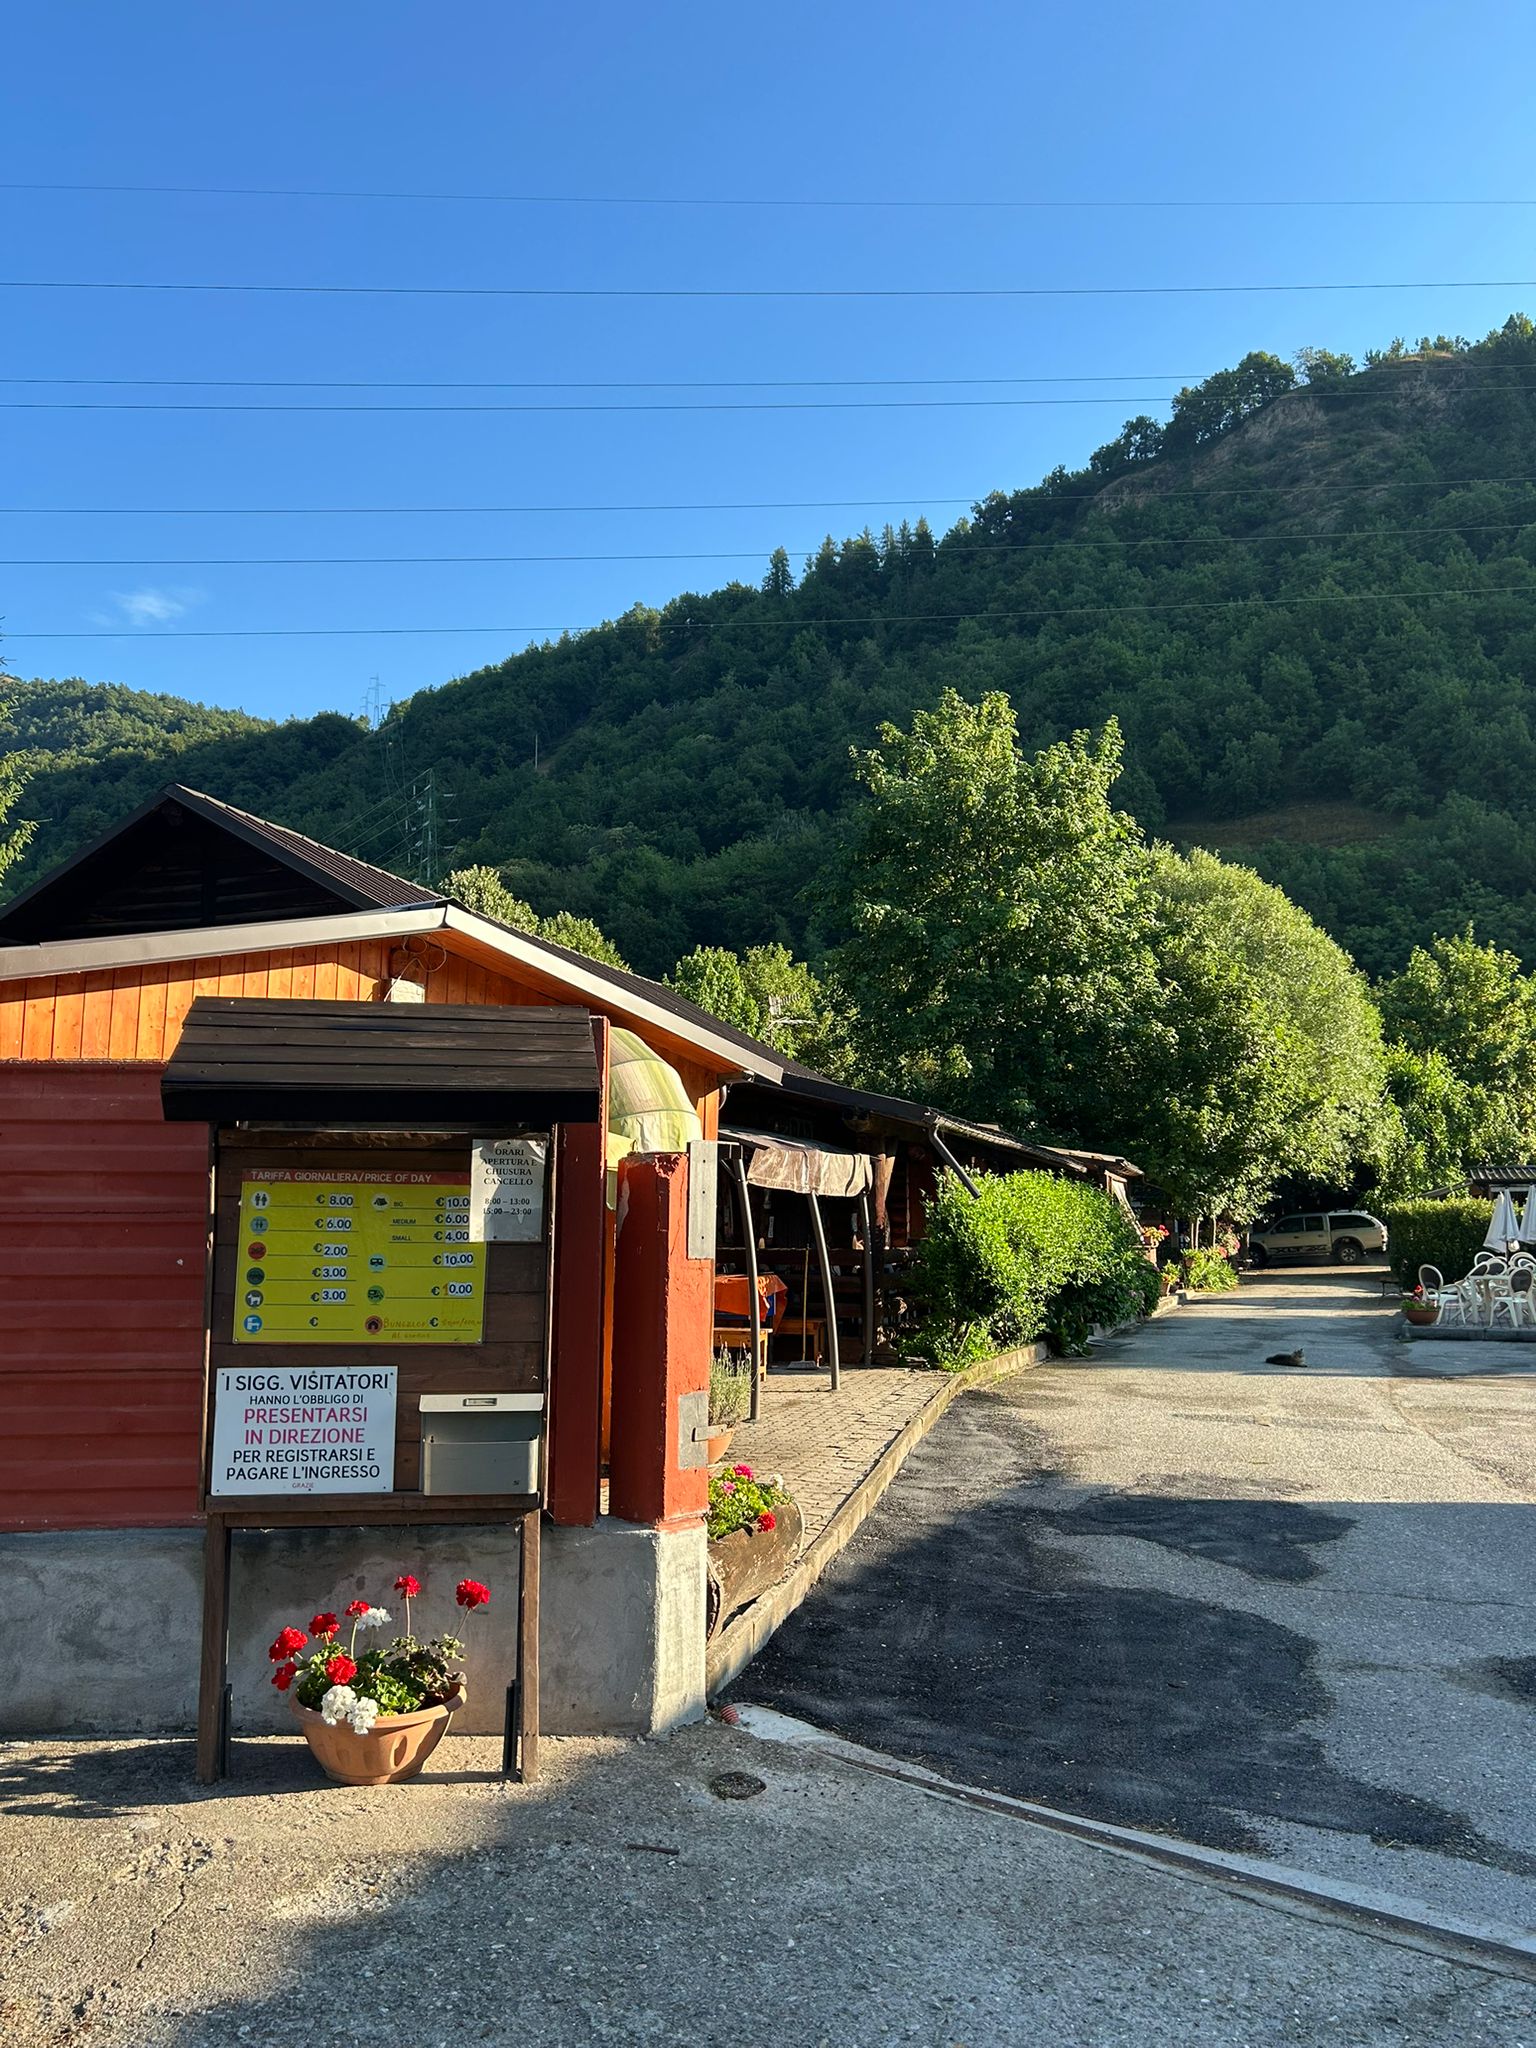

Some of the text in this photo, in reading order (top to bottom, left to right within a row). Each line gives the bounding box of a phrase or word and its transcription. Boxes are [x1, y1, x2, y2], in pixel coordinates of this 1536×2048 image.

[495, 1148, 524, 1156] ORARI
[481, 1158, 538, 1167] APERTURA E
[251, 1171, 432, 1184] TARIFFA GIORNALIERA/PRICE OF DAY
[485, 1168, 532, 1176] CHIUSURA
[483, 1177, 533, 1186] CANCELLO
[316, 1194, 354, 1206] € 8.00
[435, 1197, 445, 1207] €
[447, 1197, 470, 1208] 10.0
[314, 1218, 352, 1229] € 6.00
[434, 1214, 444, 1224] €
[446, 1214, 470, 1224] 6.00
[433, 1231, 443, 1241] €
[445, 1231, 470, 1241] 4.00
[313, 1243, 348, 1256] € 2.00
[432, 1253, 474, 1265] € 10.00
[312, 1267, 347, 1278] € 3.00
[310, 1290, 346, 1302] € 3.00
[431, 1286, 441, 1296] €
[309, 1316, 319, 1327] €
[429, 1316, 439, 1327] €
[225, 1373, 389, 1391] I SIGG. VISITATORI
[249, 1394, 364, 1405] HANNO L'OBBLIGO DI
[244, 1407, 368, 1424] PRESENTARSI
[245, 1427, 365, 1445] IN DIREZIONE
[233, 1448, 376, 1463] PER REGISTRARSI E
[226, 1465, 380, 1481] PAGARE L'INGRESSO
